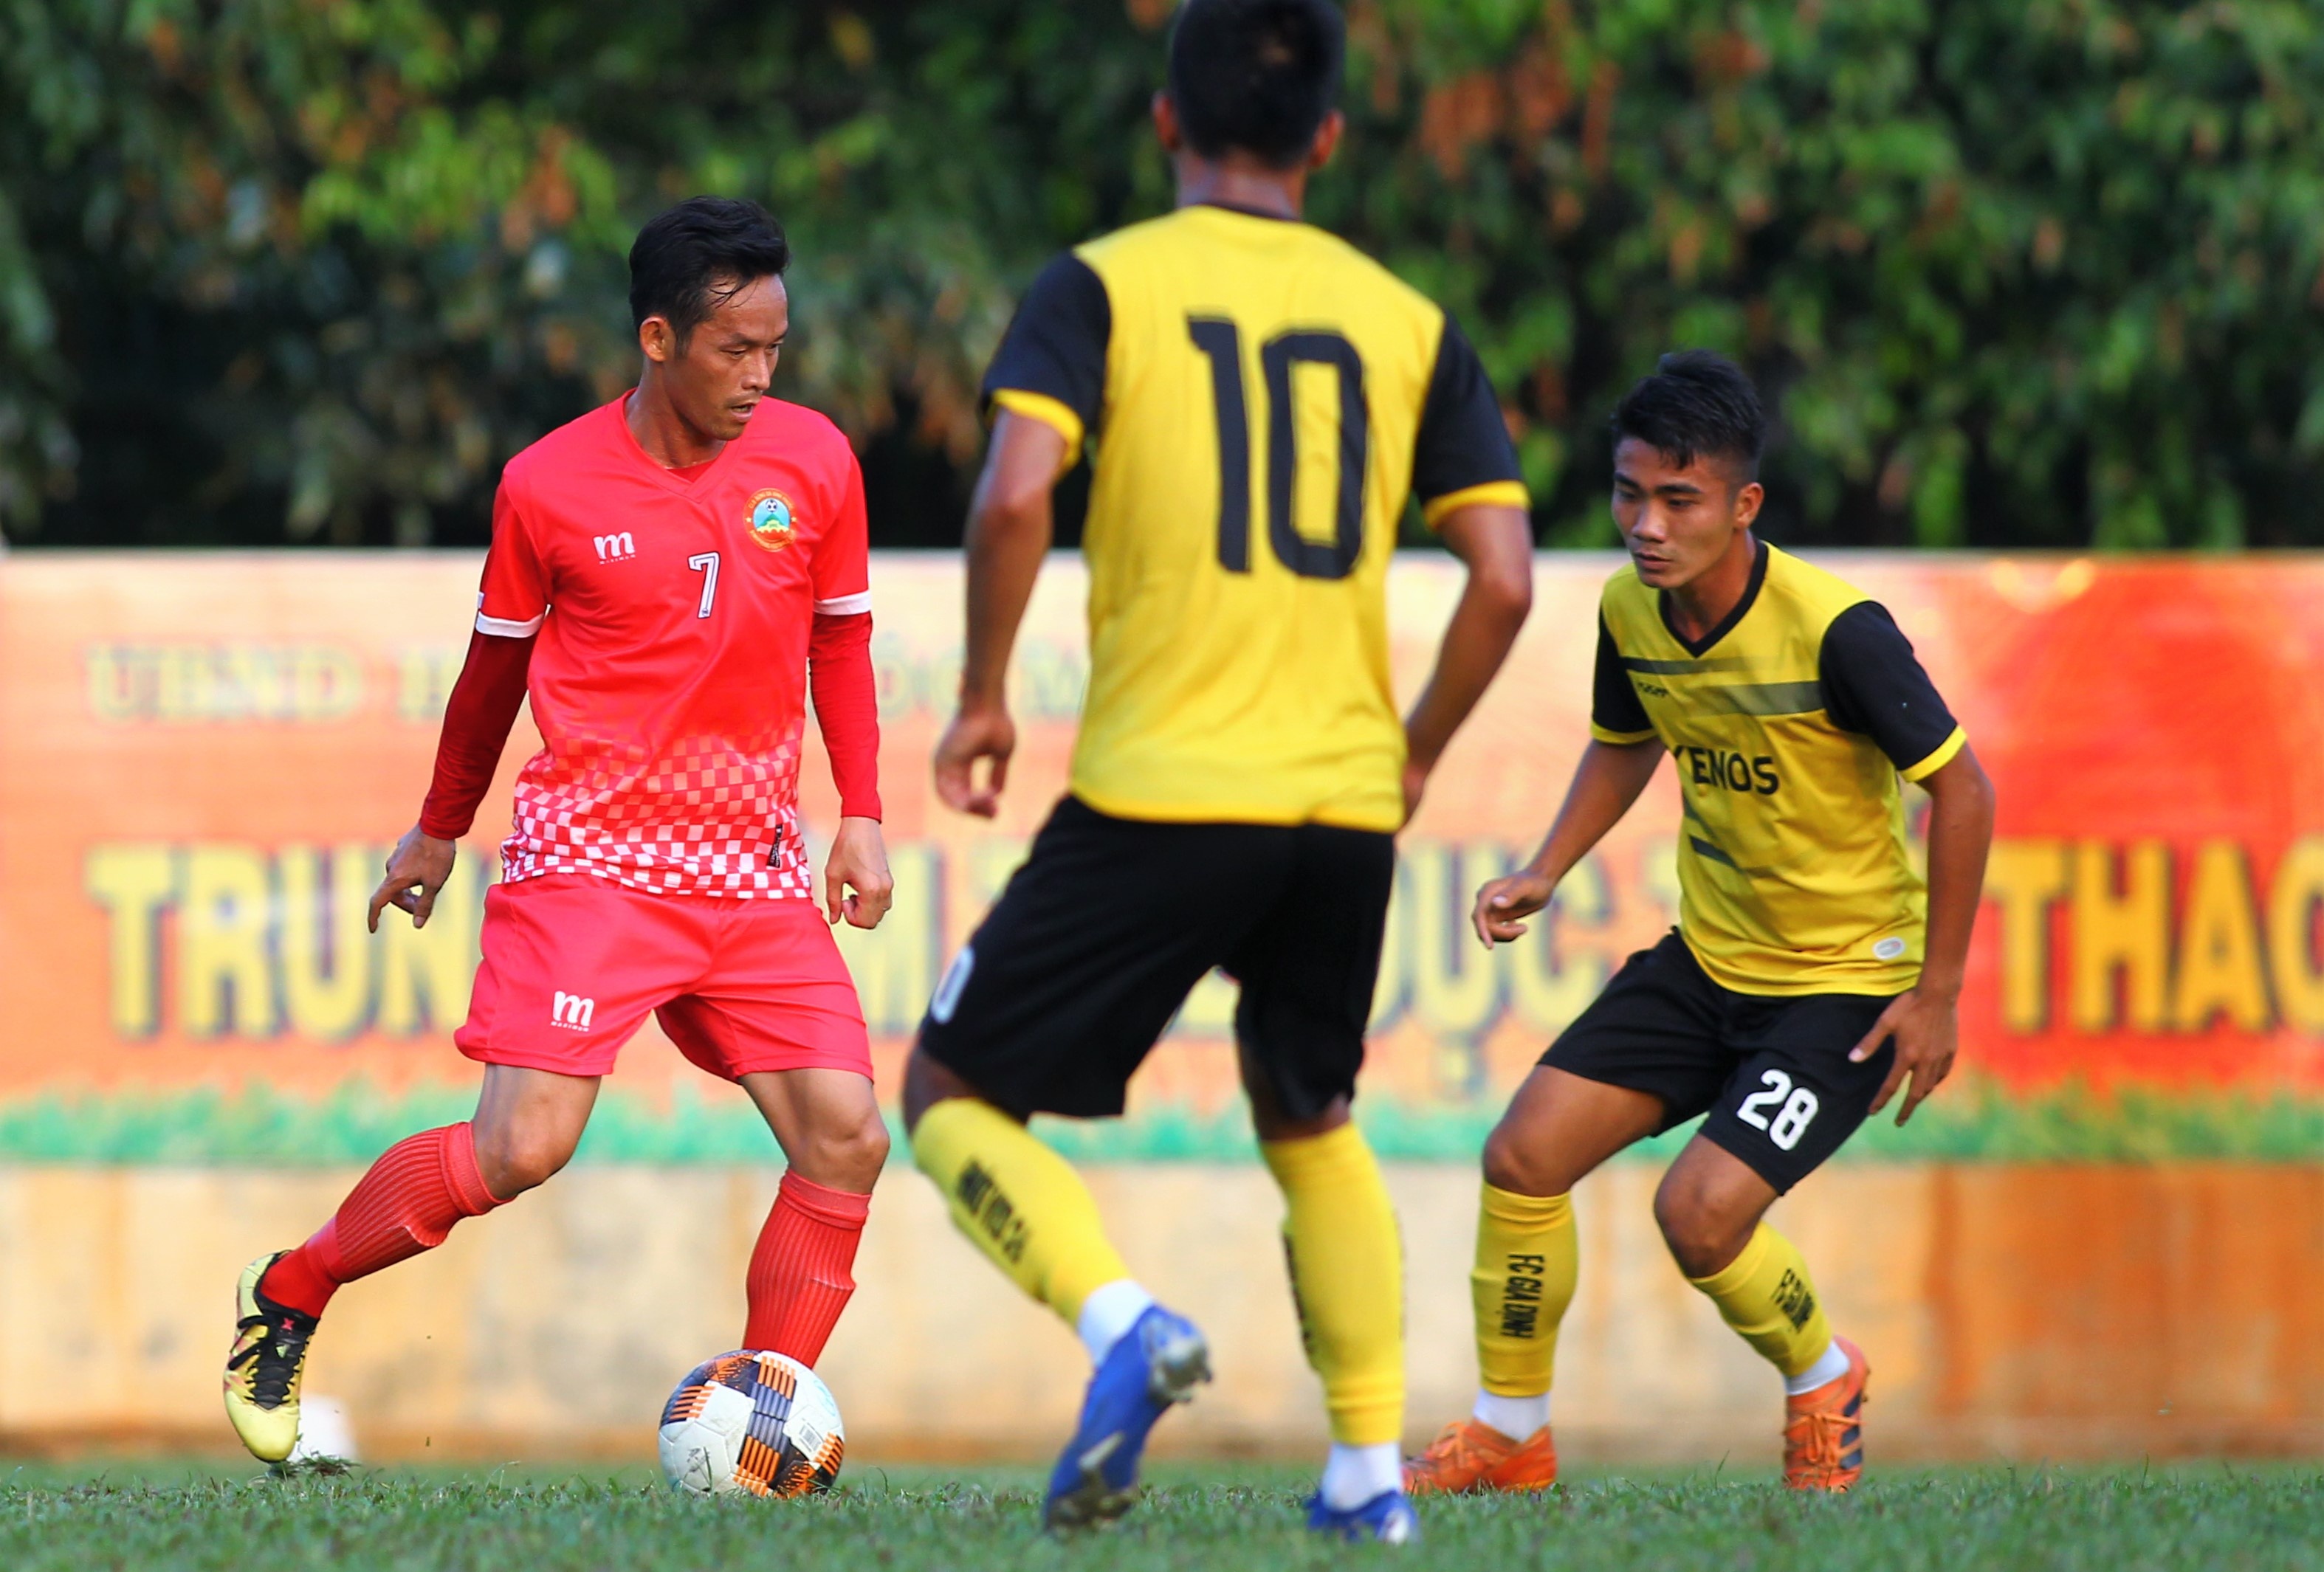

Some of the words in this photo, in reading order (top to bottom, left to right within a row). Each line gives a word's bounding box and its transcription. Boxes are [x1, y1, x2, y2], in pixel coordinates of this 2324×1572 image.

[1184, 314, 1370, 580] 10
[688, 551, 721, 618] 7
[87, 641, 364, 720] UBND
[86, 841, 493, 1039] TRUN
[1736, 1068, 1819, 1151] 28
[1507, 1254, 1544, 1276] FC
